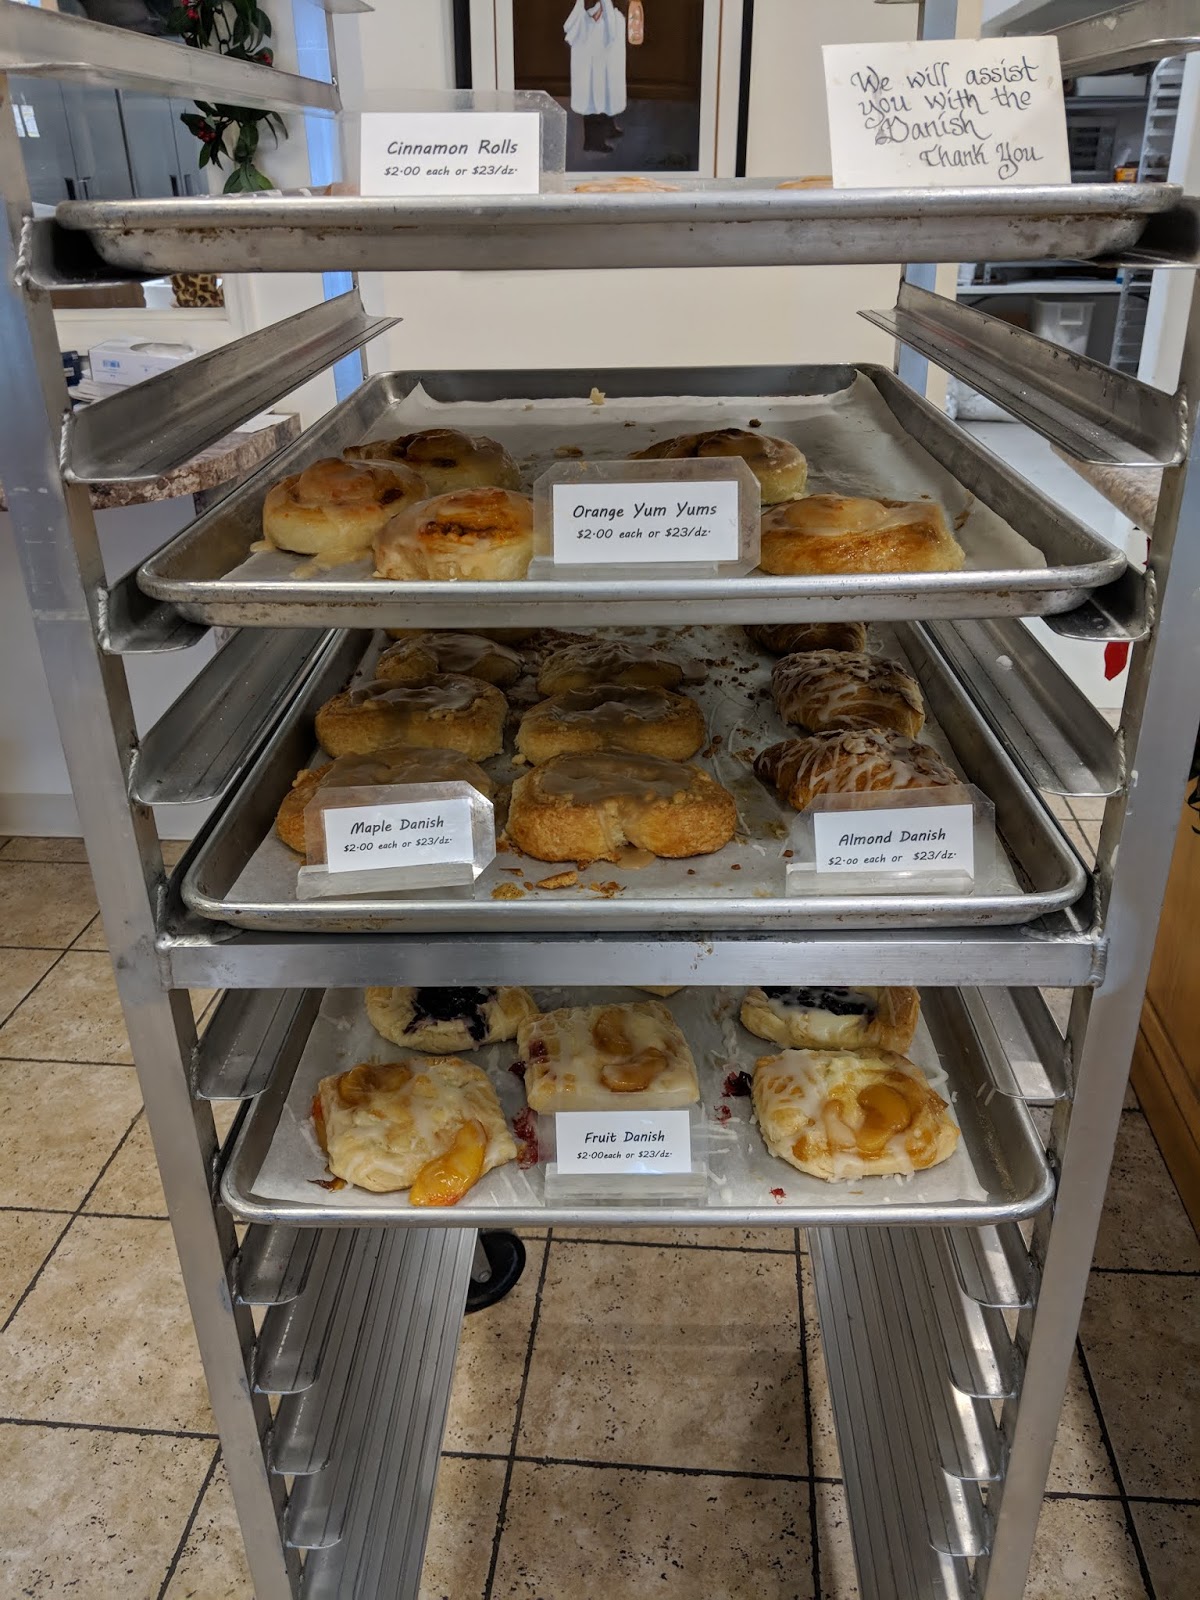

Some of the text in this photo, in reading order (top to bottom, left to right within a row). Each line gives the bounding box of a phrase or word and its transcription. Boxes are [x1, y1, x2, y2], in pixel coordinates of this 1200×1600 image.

[850, 56, 1039, 93] We will assist
[858, 85, 1032, 130] you with the
[874, 109, 992, 146] Danish
[387, 139, 518, 155] Cinnamon Rolls
[919, 142, 1044, 181] Thank You
[426, 165, 450, 176] each
[455, 168, 468, 176] or
[572, 501, 717, 521] Orange Yum Yums
[619, 528, 643, 539] each
[648, 530, 661, 539] or
[350, 815, 444, 836] Maple Danish
[378, 840, 397, 850] each
[402, 840, 412, 848] or
[838, 828, 946, 847] Almond Danish
[863, 854, 886, 864] each
[891, 855, 903, 863] or
[584, 1130, 665, 1144] Fruit Danish
[625, 1151, 635, 1159] or
